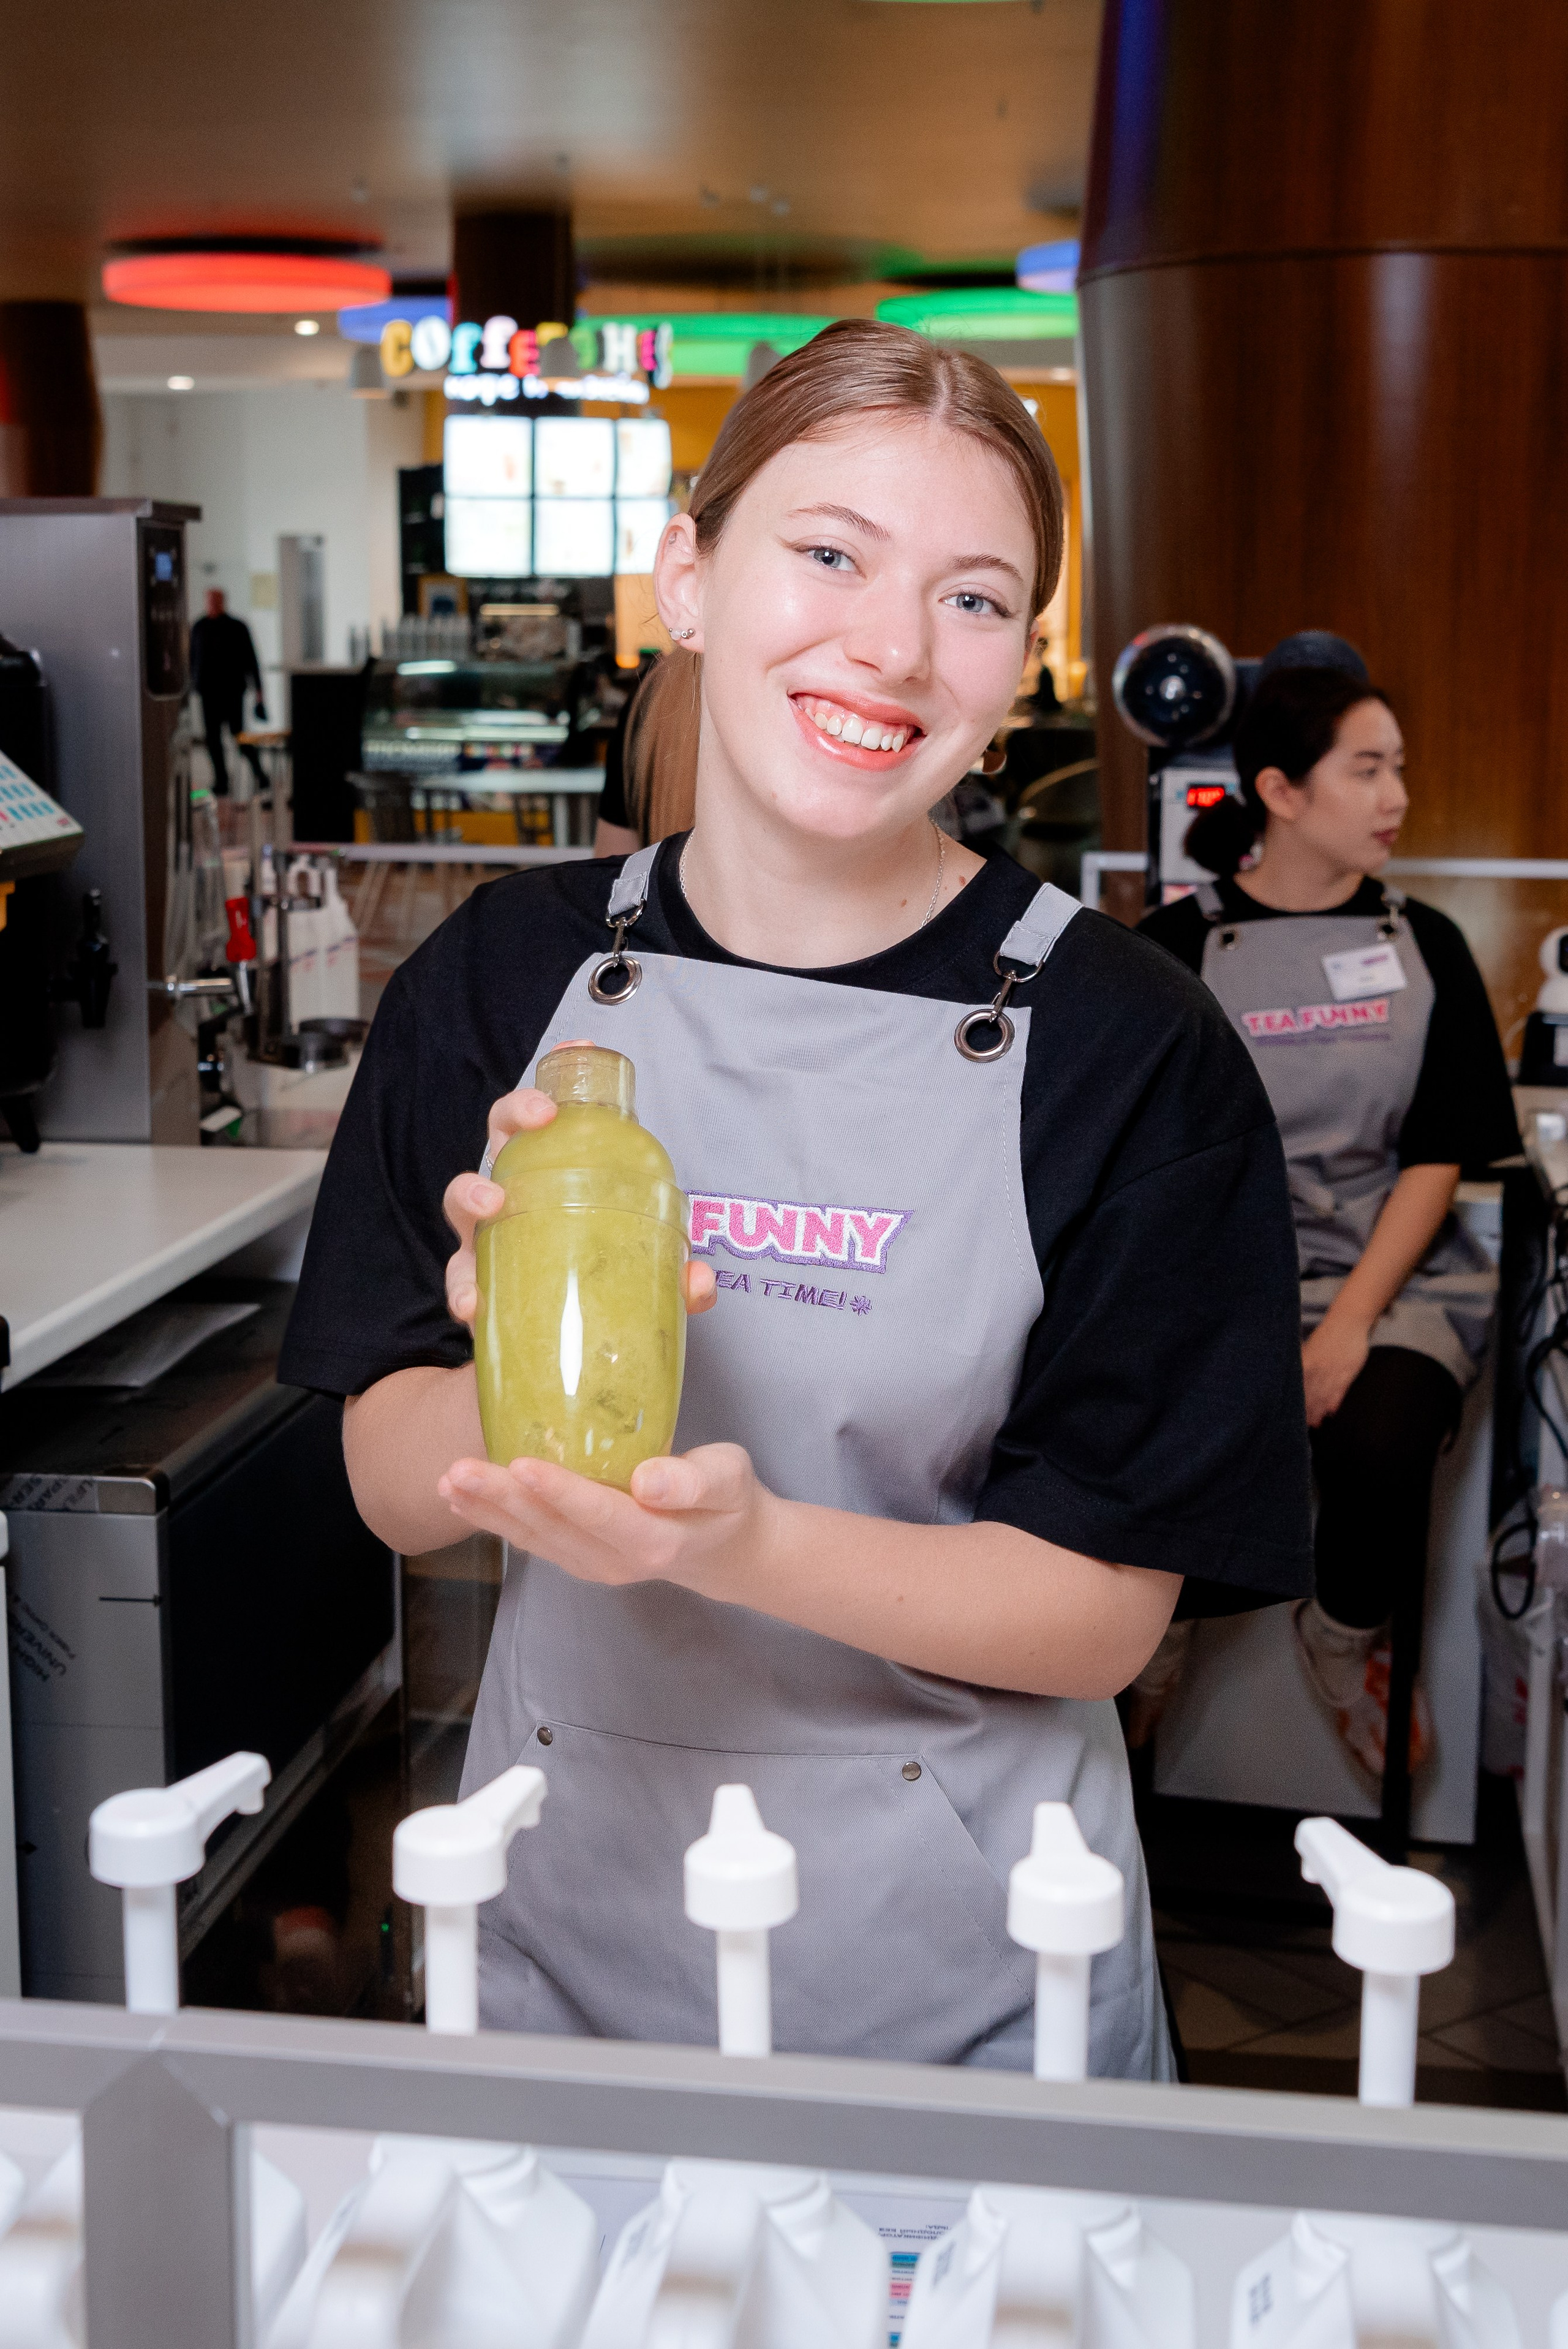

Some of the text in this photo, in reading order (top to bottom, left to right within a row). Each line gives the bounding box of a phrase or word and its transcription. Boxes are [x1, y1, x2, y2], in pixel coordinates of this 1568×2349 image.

[690, 1195, 905, 1267] FUNNY
[714, 1269, 848, 1311] EA TIME!
